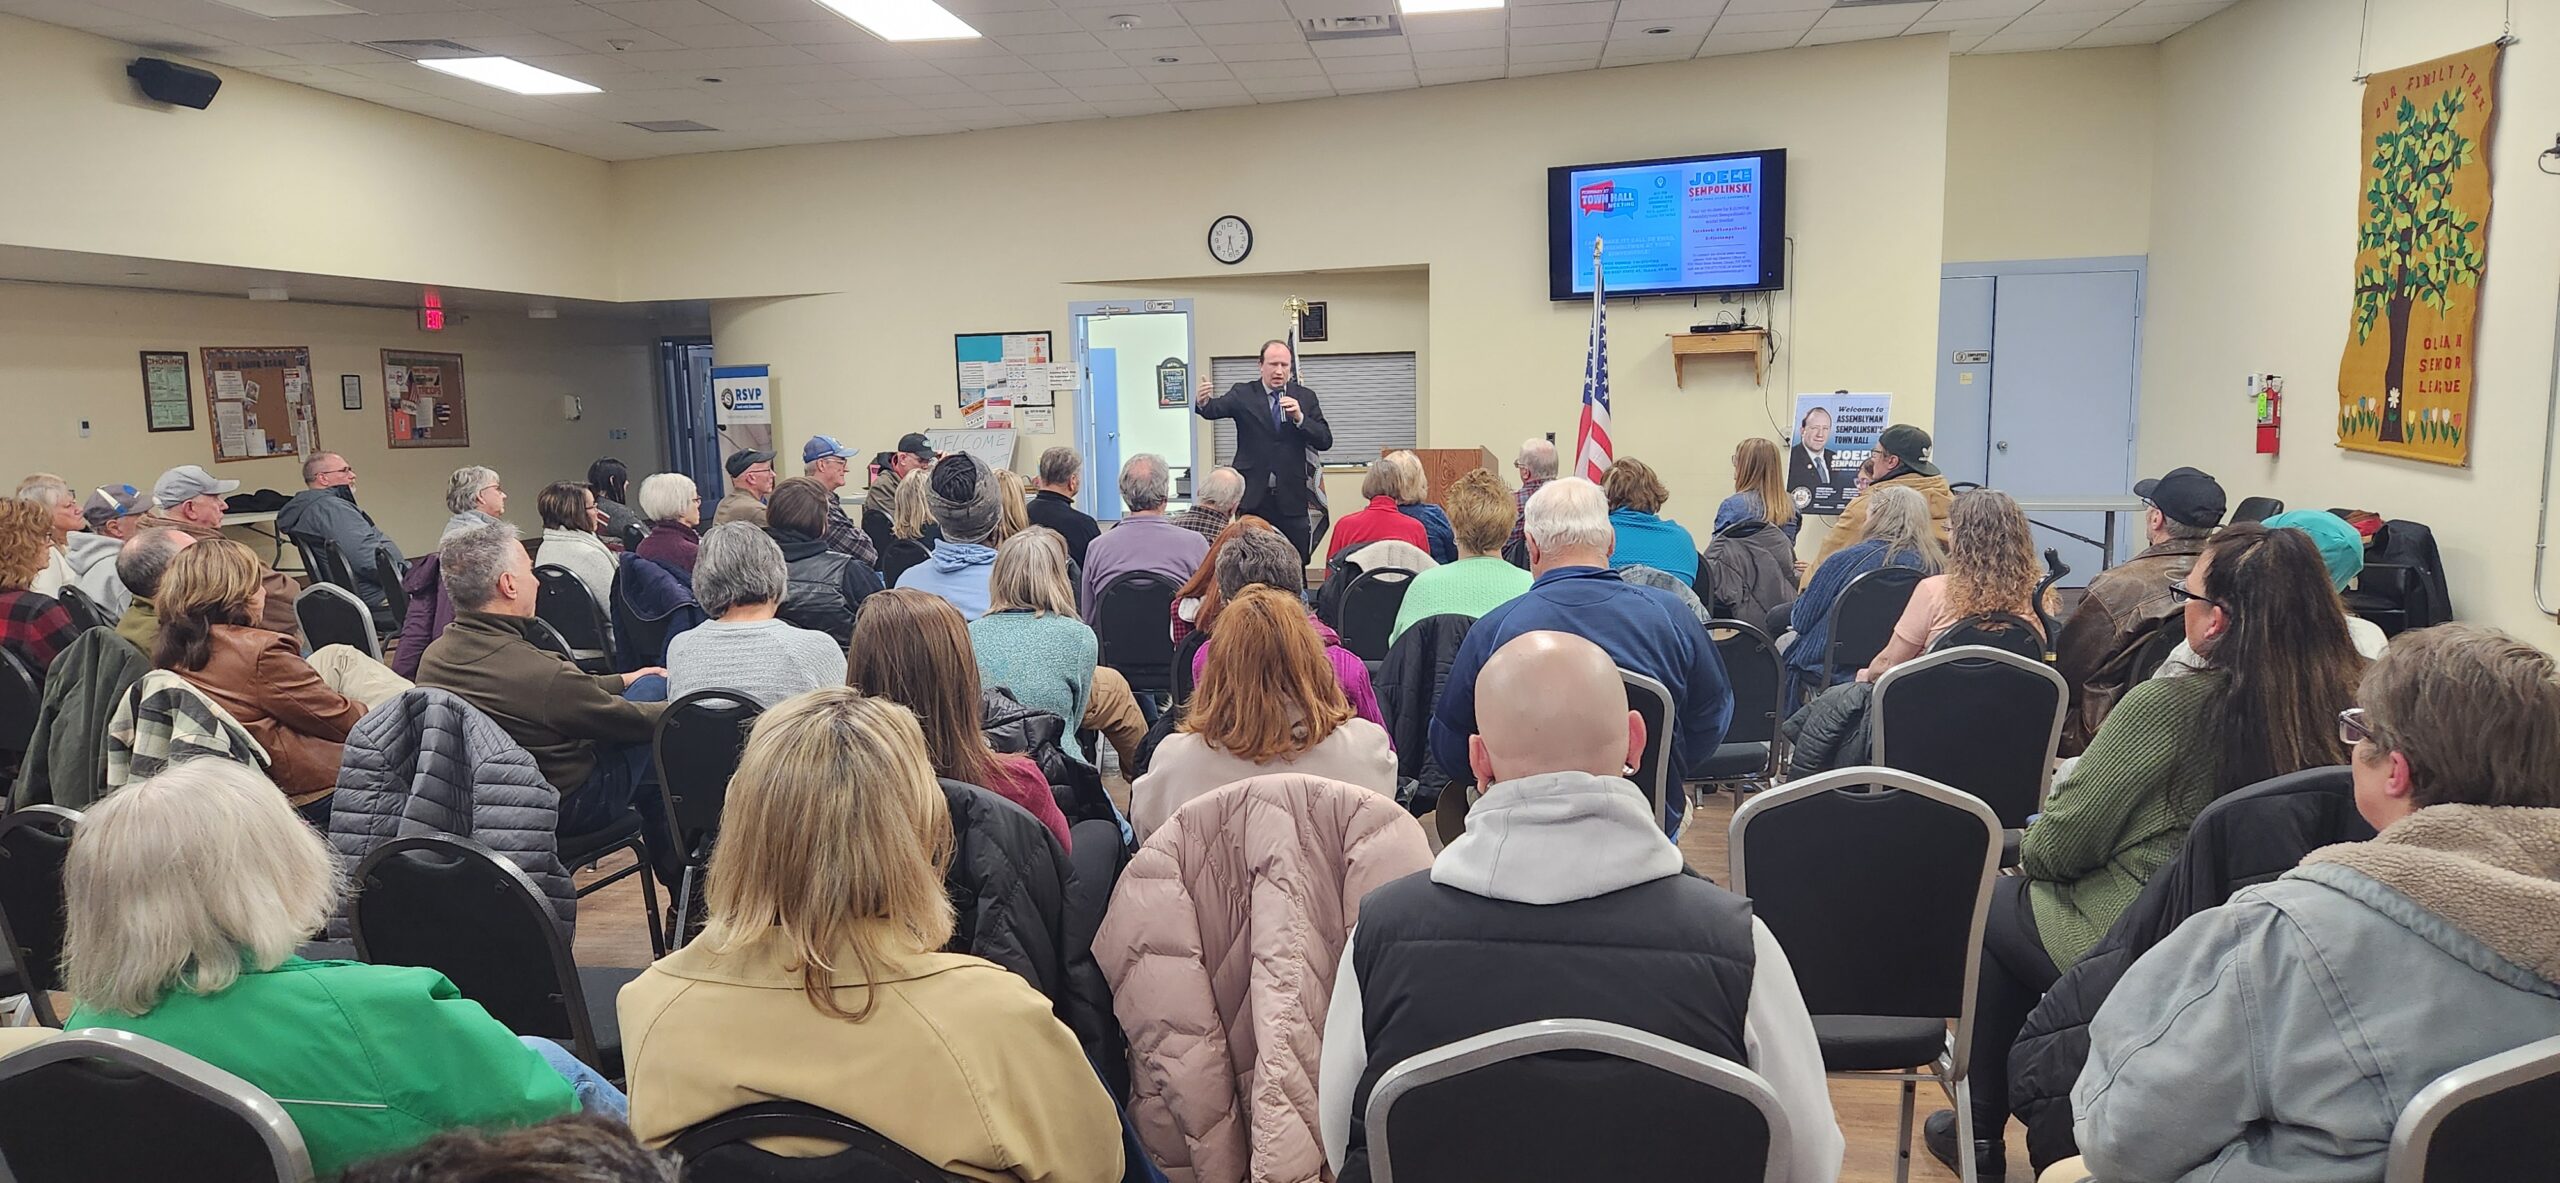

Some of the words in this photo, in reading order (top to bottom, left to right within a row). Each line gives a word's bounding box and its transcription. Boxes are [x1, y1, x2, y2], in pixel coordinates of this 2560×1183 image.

[2375, 85, 2397, 118] OUR
[2460, 63, 2485, 112] TREE
[1689, 170, 1729, 186] JOE
[1688, 183, 1752, 198] SEMPOLINSKI
[1581, 193, 1609, 205] TOWN
[1610, 192, 1635, 202] HALL
[1607, 201, 1635, 209] MEETING
[426, 310, 444, 329] EXIT
[146, 358, 183, 366] CHOKING
[2419, 356, 2461, 372] SENIOR
[2418, 380, 2461, 394] LEAGUE
[735, 388, 762, 401] RSVP
[1837, 414, 1884, 423] ASSEMBLYMAN
[1836, 425, 1884, 434] SEMPOLINSKI'S
[930, 433, 1006, 451] WELCOME
[1834, 436, 1853, 444] TOWN
[1853, 436, 1869, 444] HALL
[1831, 449, 1860, 460] JOE
